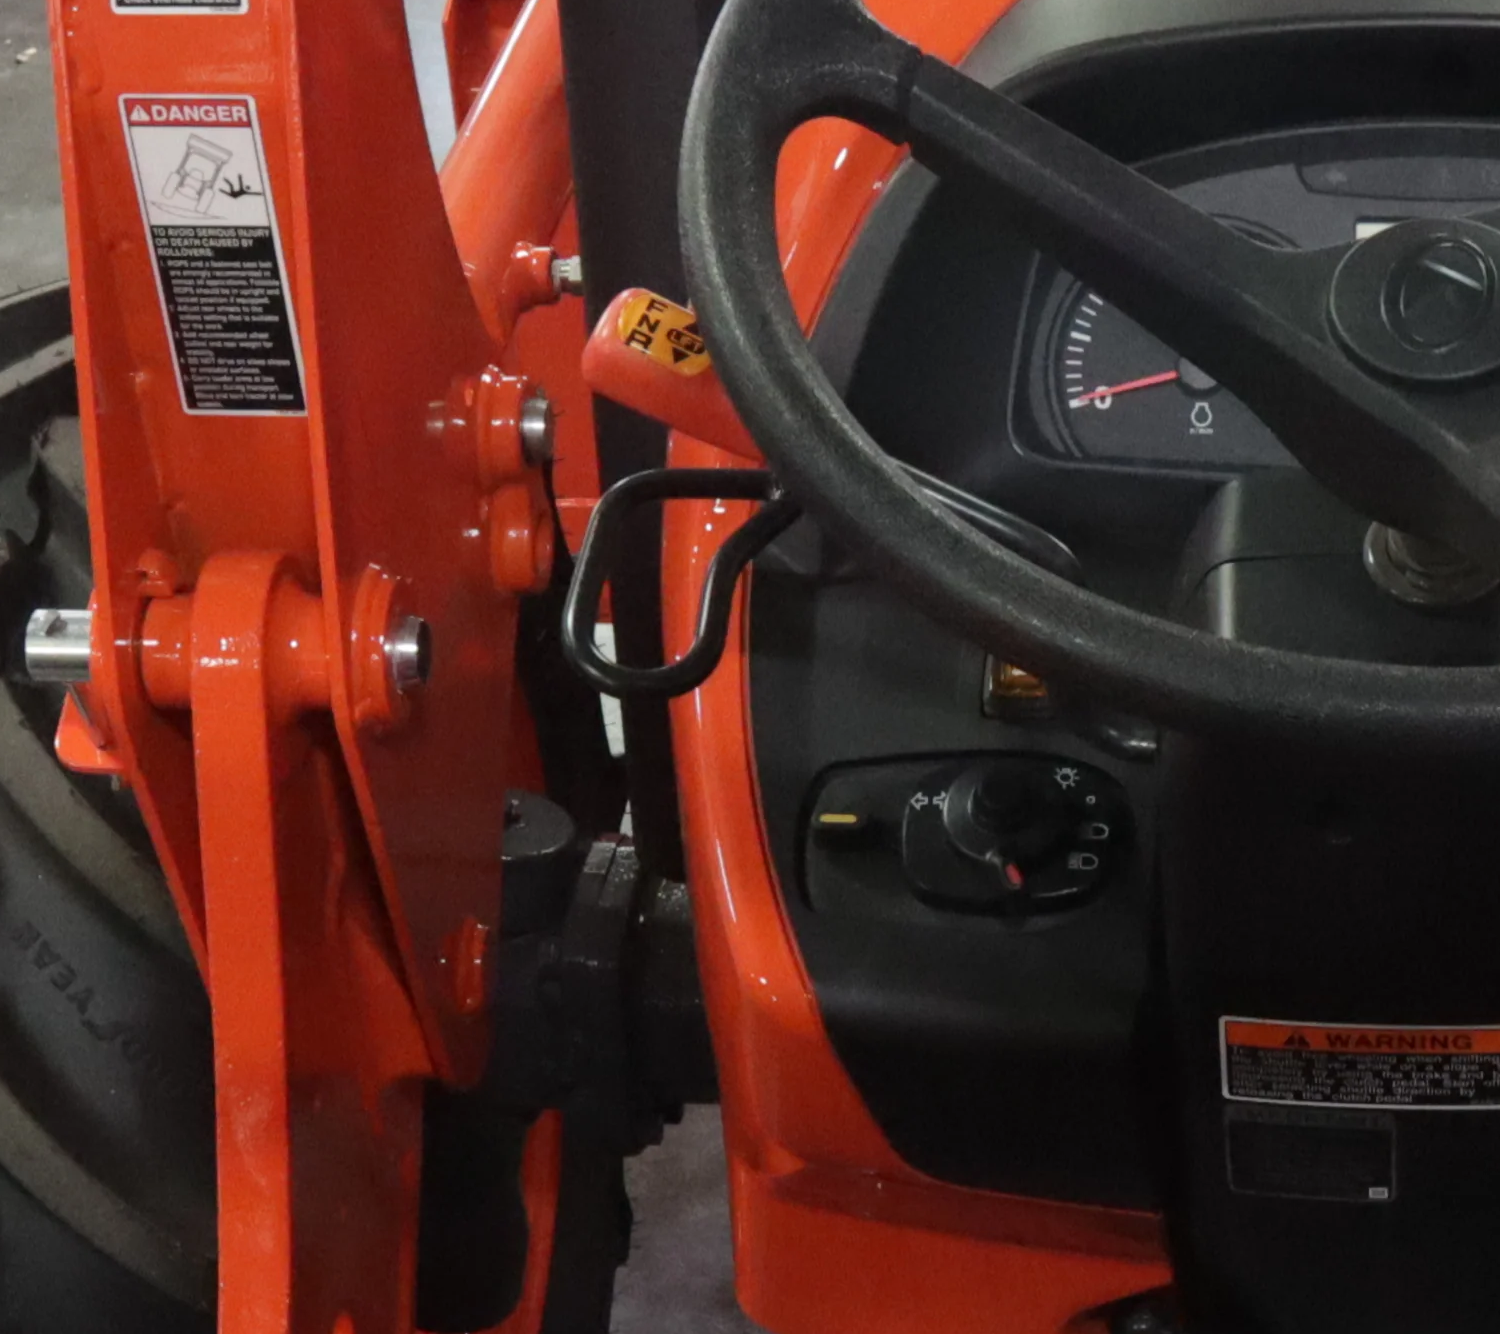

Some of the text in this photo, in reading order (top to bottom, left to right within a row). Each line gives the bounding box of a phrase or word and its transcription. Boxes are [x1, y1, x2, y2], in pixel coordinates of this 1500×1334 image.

[151, 105, 248, 122] DANGER
[152, 227, 270, 237] TO AVOID SERIOUS INJURY
[155, 238, 253, 248] OR DEATH CAUSED BY
[637, 314, 661, 335] N
[1326, 1032, 1472, 1050] WARNING
